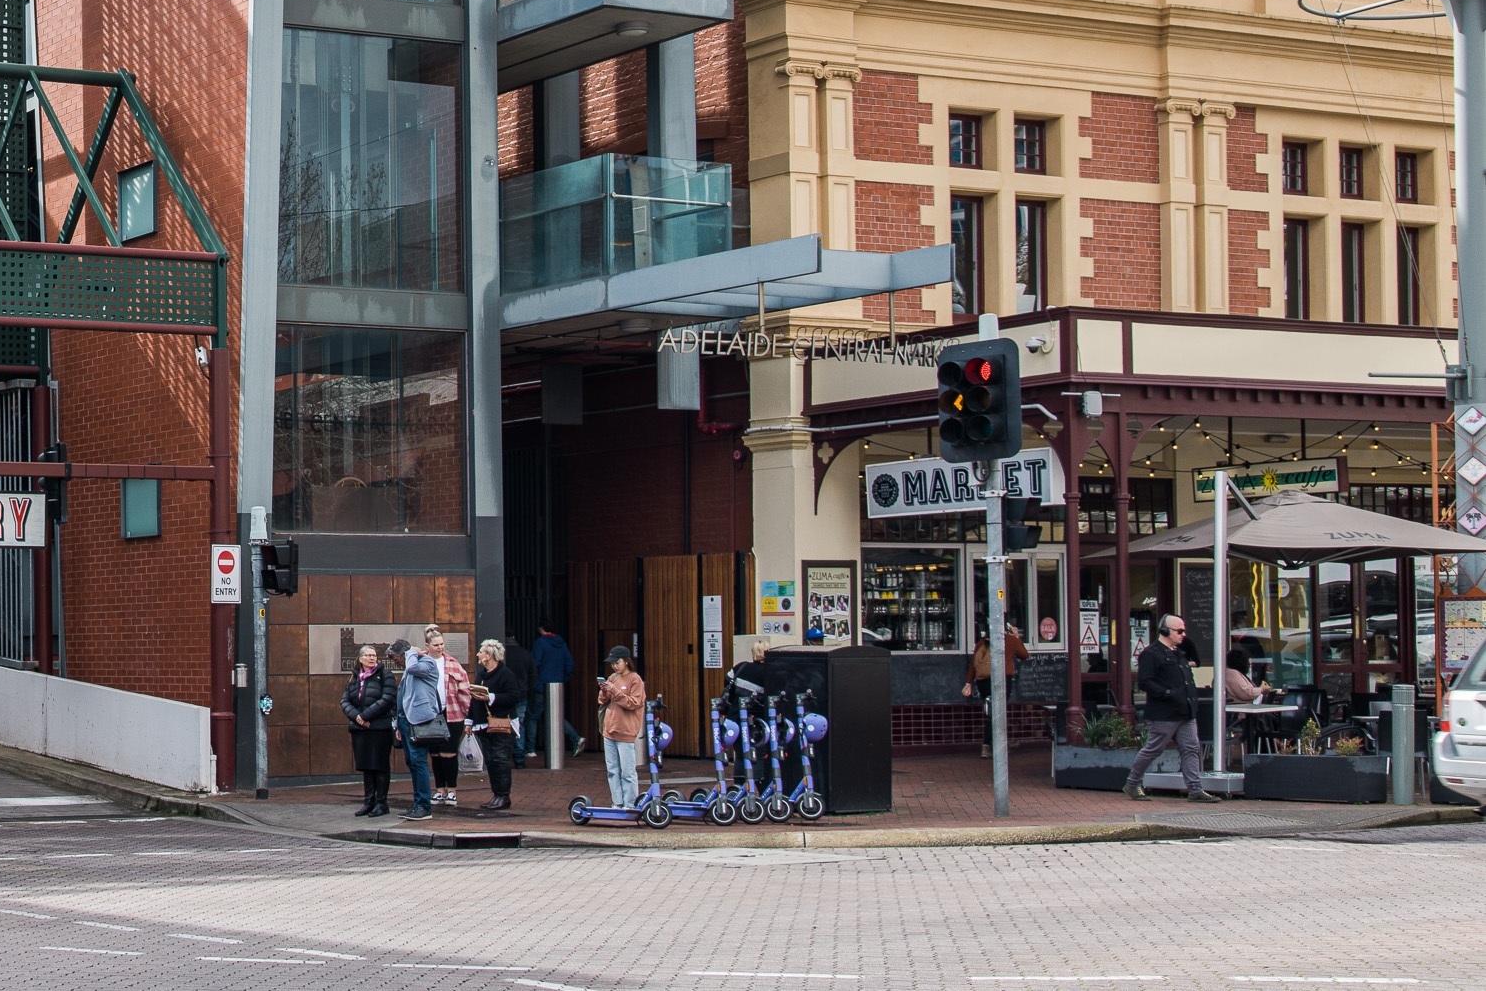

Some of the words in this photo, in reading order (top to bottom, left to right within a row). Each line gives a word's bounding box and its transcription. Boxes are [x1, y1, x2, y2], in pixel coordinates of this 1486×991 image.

[657, 327, 783, 358] ADELAIDE
[793, 335, 887, 364] CENTRAL
[893, 339, 939, 367] MARK
[1285, 465, 1333, 488] caffe
[902, 458, 1045, 505] MARET
[1323, 531, 1391, 540] ZUMA
[811, 572, 833, 580] ZUMA
[221, 577, 231, 585] NO
[215, 588, 237, 596] ENTRY
